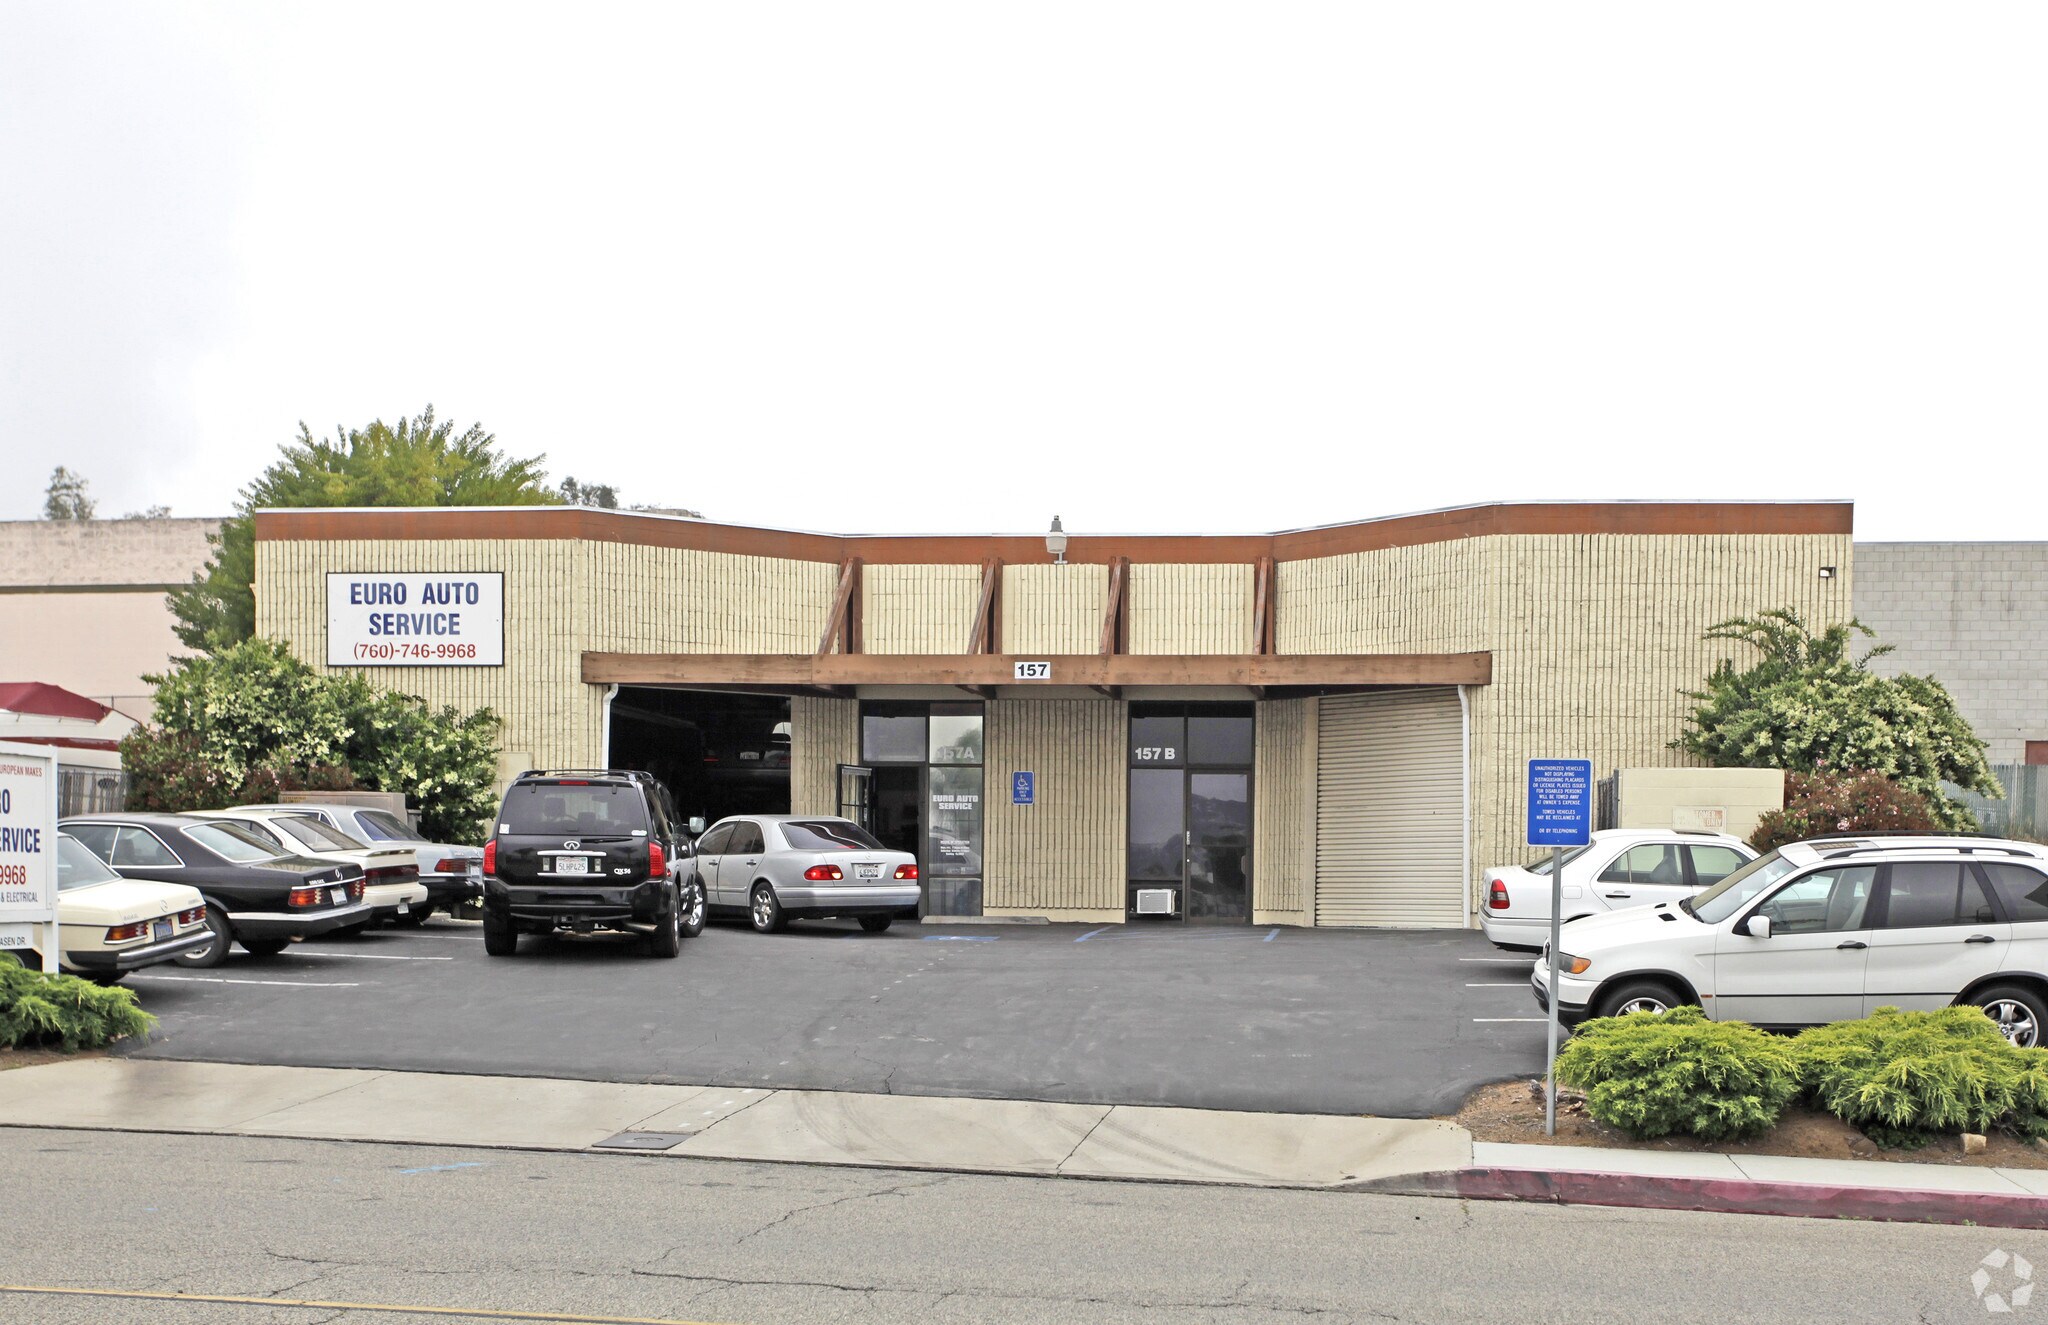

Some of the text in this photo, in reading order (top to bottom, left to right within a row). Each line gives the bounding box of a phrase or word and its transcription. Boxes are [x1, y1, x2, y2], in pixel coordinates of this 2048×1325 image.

[350, 582, 479, 605] EURO AUTO
[369, 613, 461, 636] SERVICE
[353, 641, 476, 660] (760)-746-9968
[1018, 664, 1047, 676] 157
[1135, 748, 1176, 760] 157 B
[24, 767, 43, 777] MAKES
[932, 794, 979, 803] EURO AUTO
[938, 802, 973, 810] SERVICE
[0, 827, 40, 853] RVICE
[6, 892, 38, 903] ELECTRICAL
